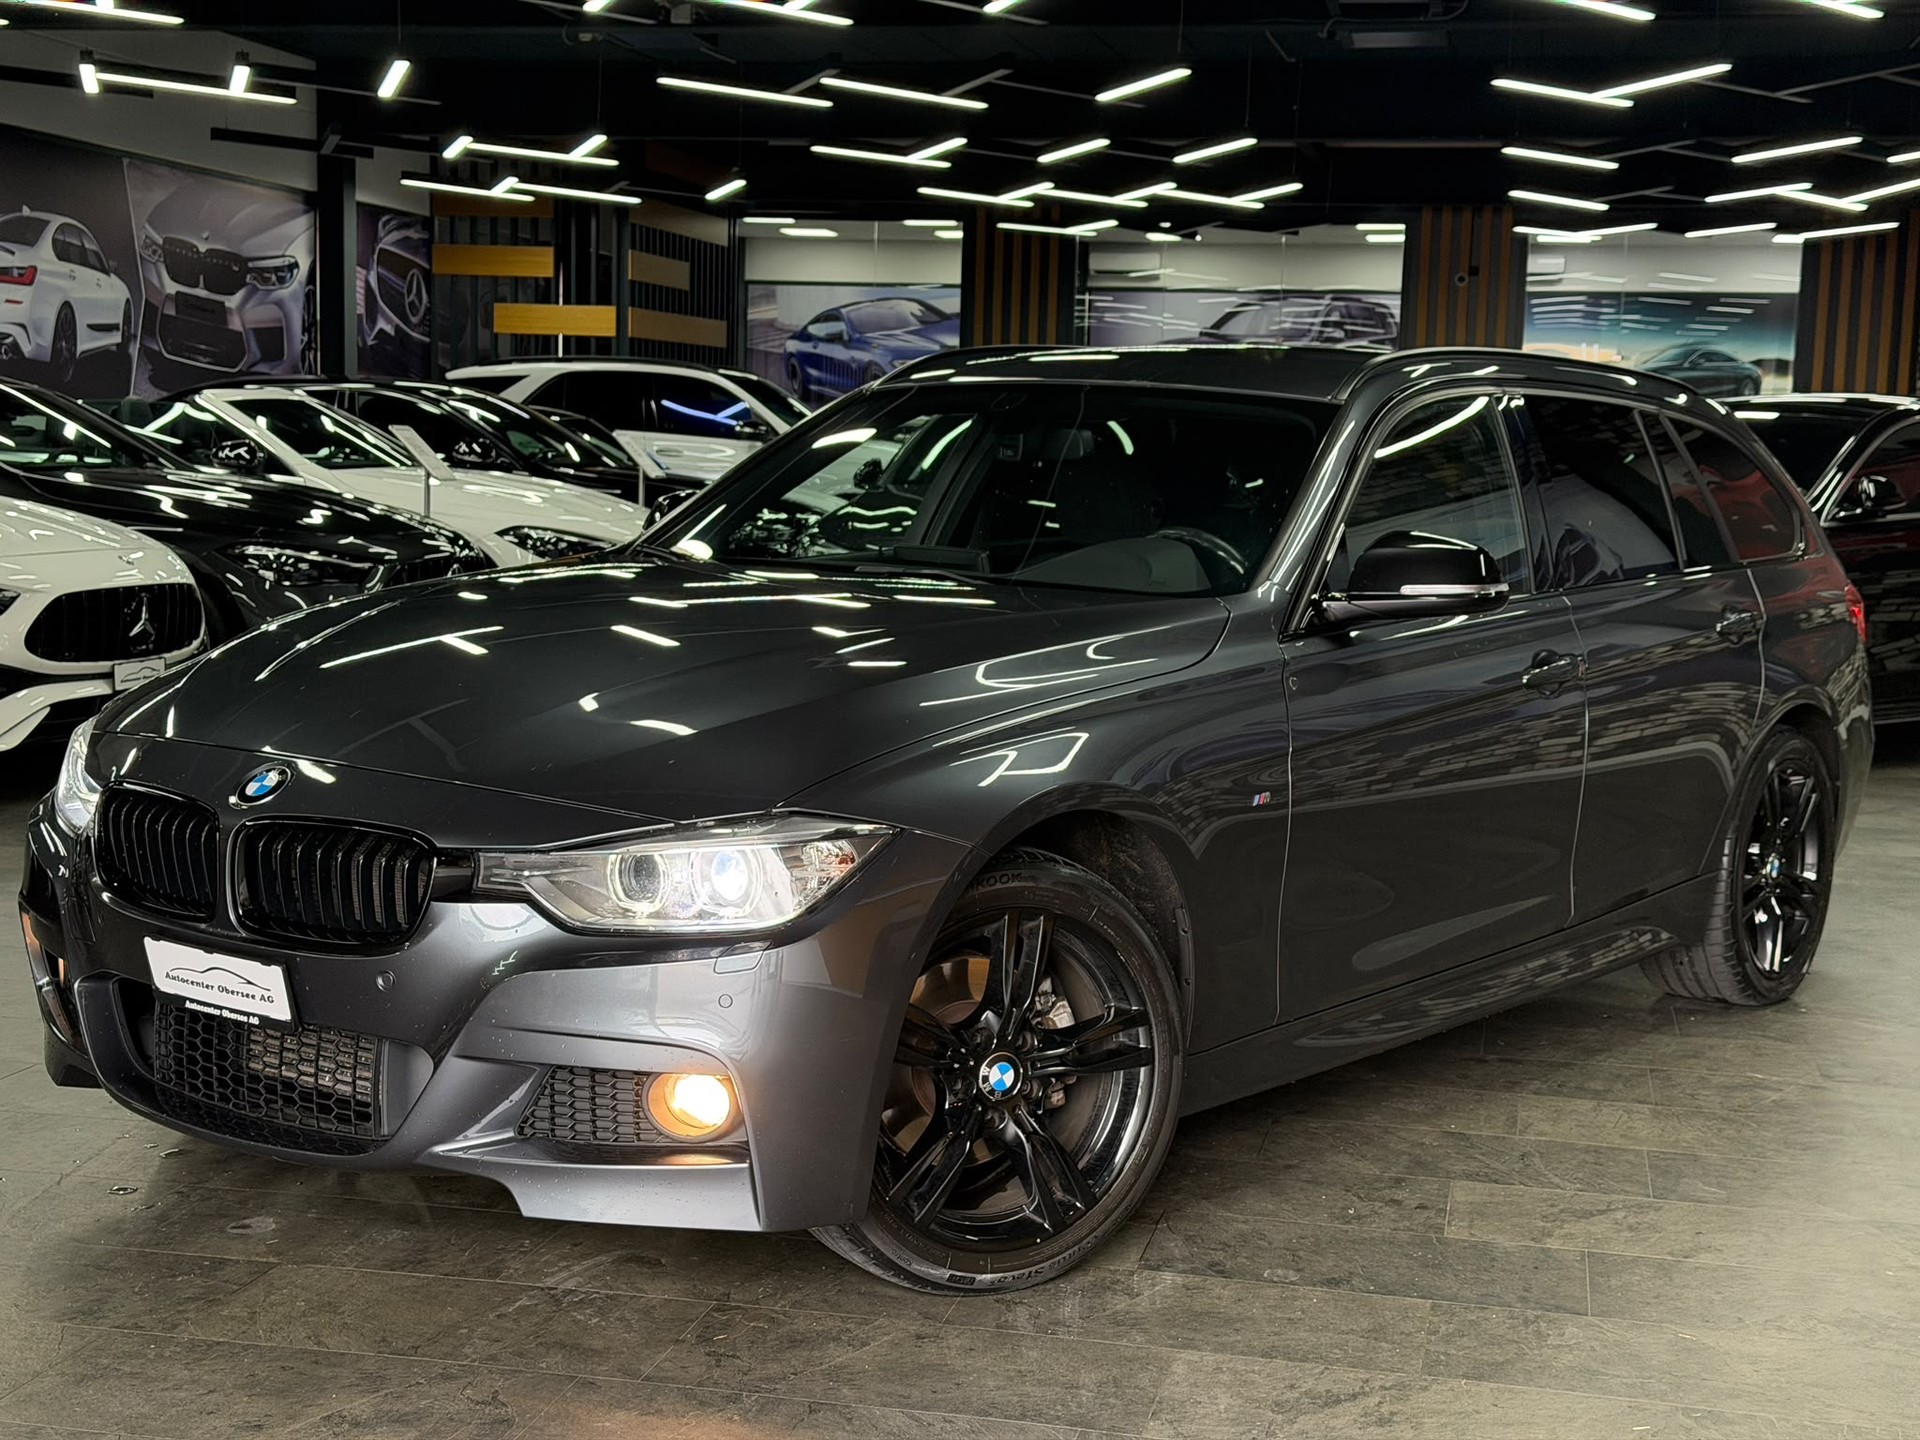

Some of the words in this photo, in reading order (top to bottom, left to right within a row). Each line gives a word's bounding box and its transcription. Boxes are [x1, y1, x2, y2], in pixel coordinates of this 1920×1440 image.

[165, 971, 215, 992] Autocenter
[217, 984, 256, 1000] Obersee
[259, 994, 275, 1004] AG
[185, 1000, 221, 1016] Autocenter
